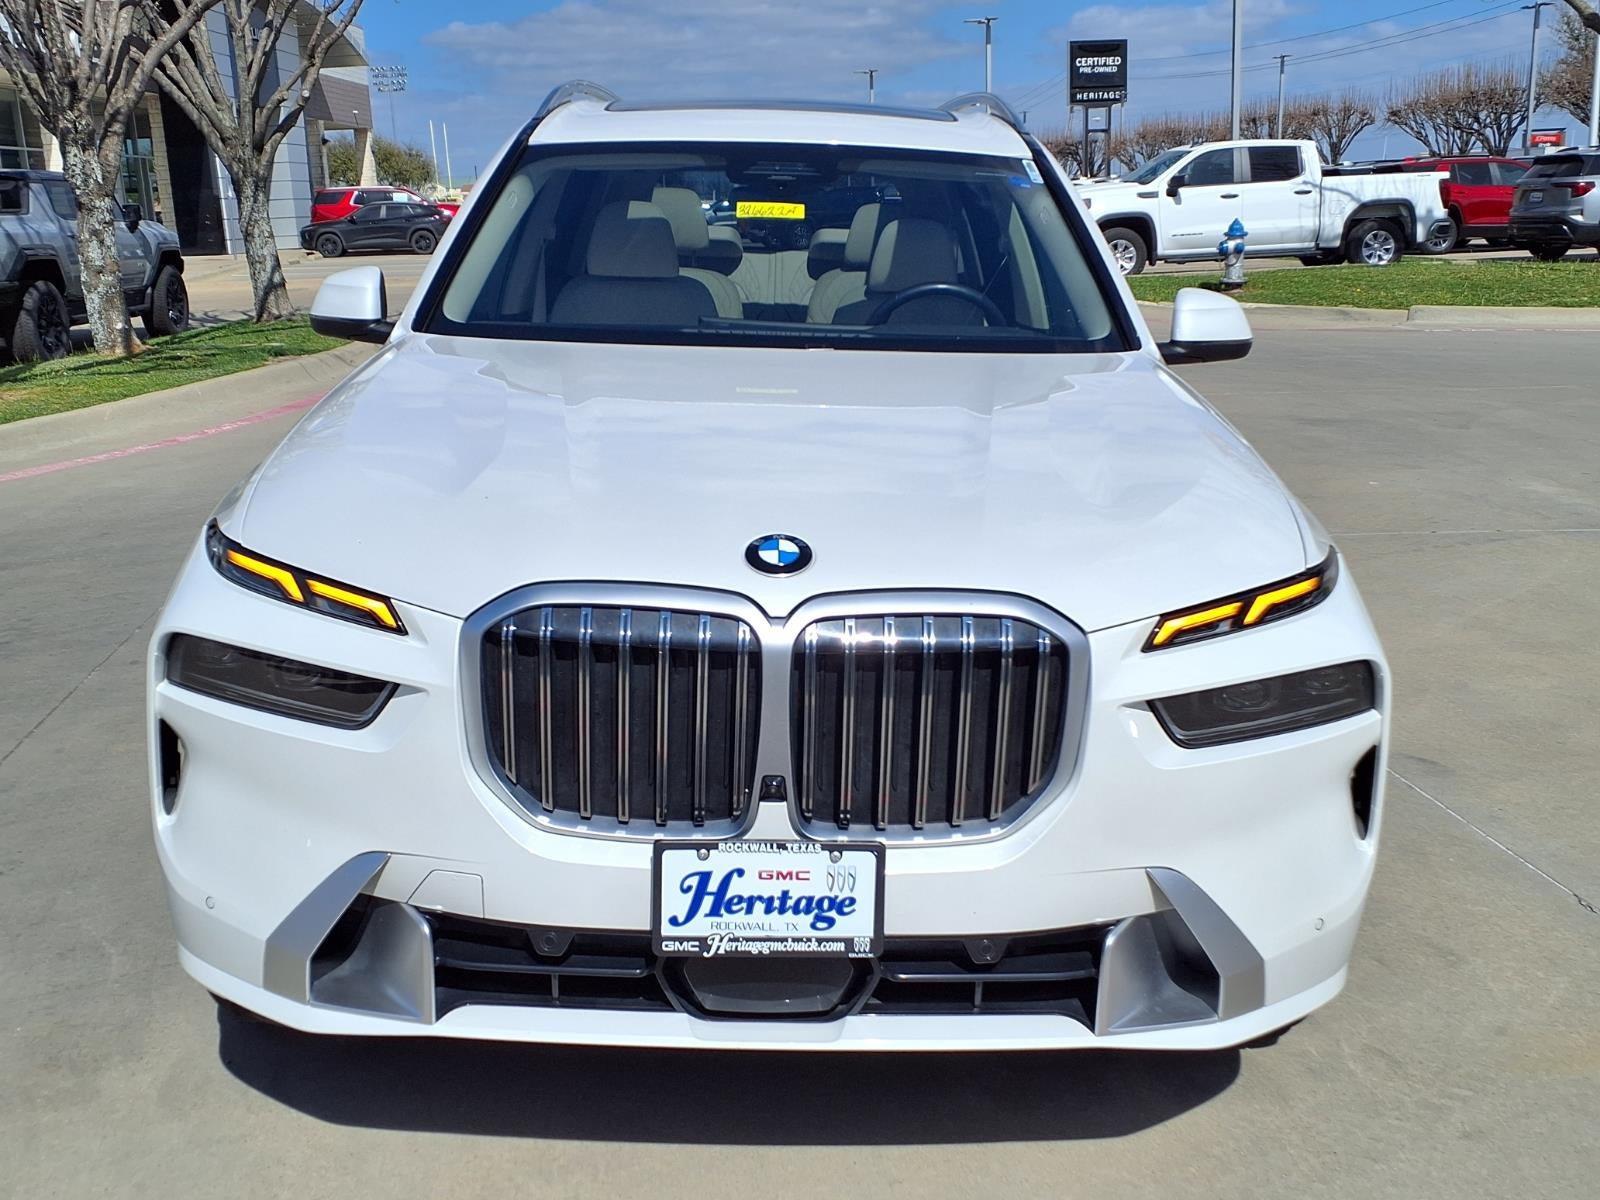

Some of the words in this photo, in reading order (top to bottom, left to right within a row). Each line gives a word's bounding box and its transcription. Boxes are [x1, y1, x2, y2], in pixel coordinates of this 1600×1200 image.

[1075, 56, 1122, 66] CERTIFIED
[1076, 91, 1121, 100] HERITAGE
[718, 842, 783, 854] ROCKWALL,
[786, 842, 822, 853] TEXAS
[757, 870, 810, 881] GMC
[668, 867, 856, 931] Heritage
[786, 922, 799, 932] TX
[662, 941, 700, 951] GMC
[703, 932, 845, 957] Heritagegmcbuick.com
